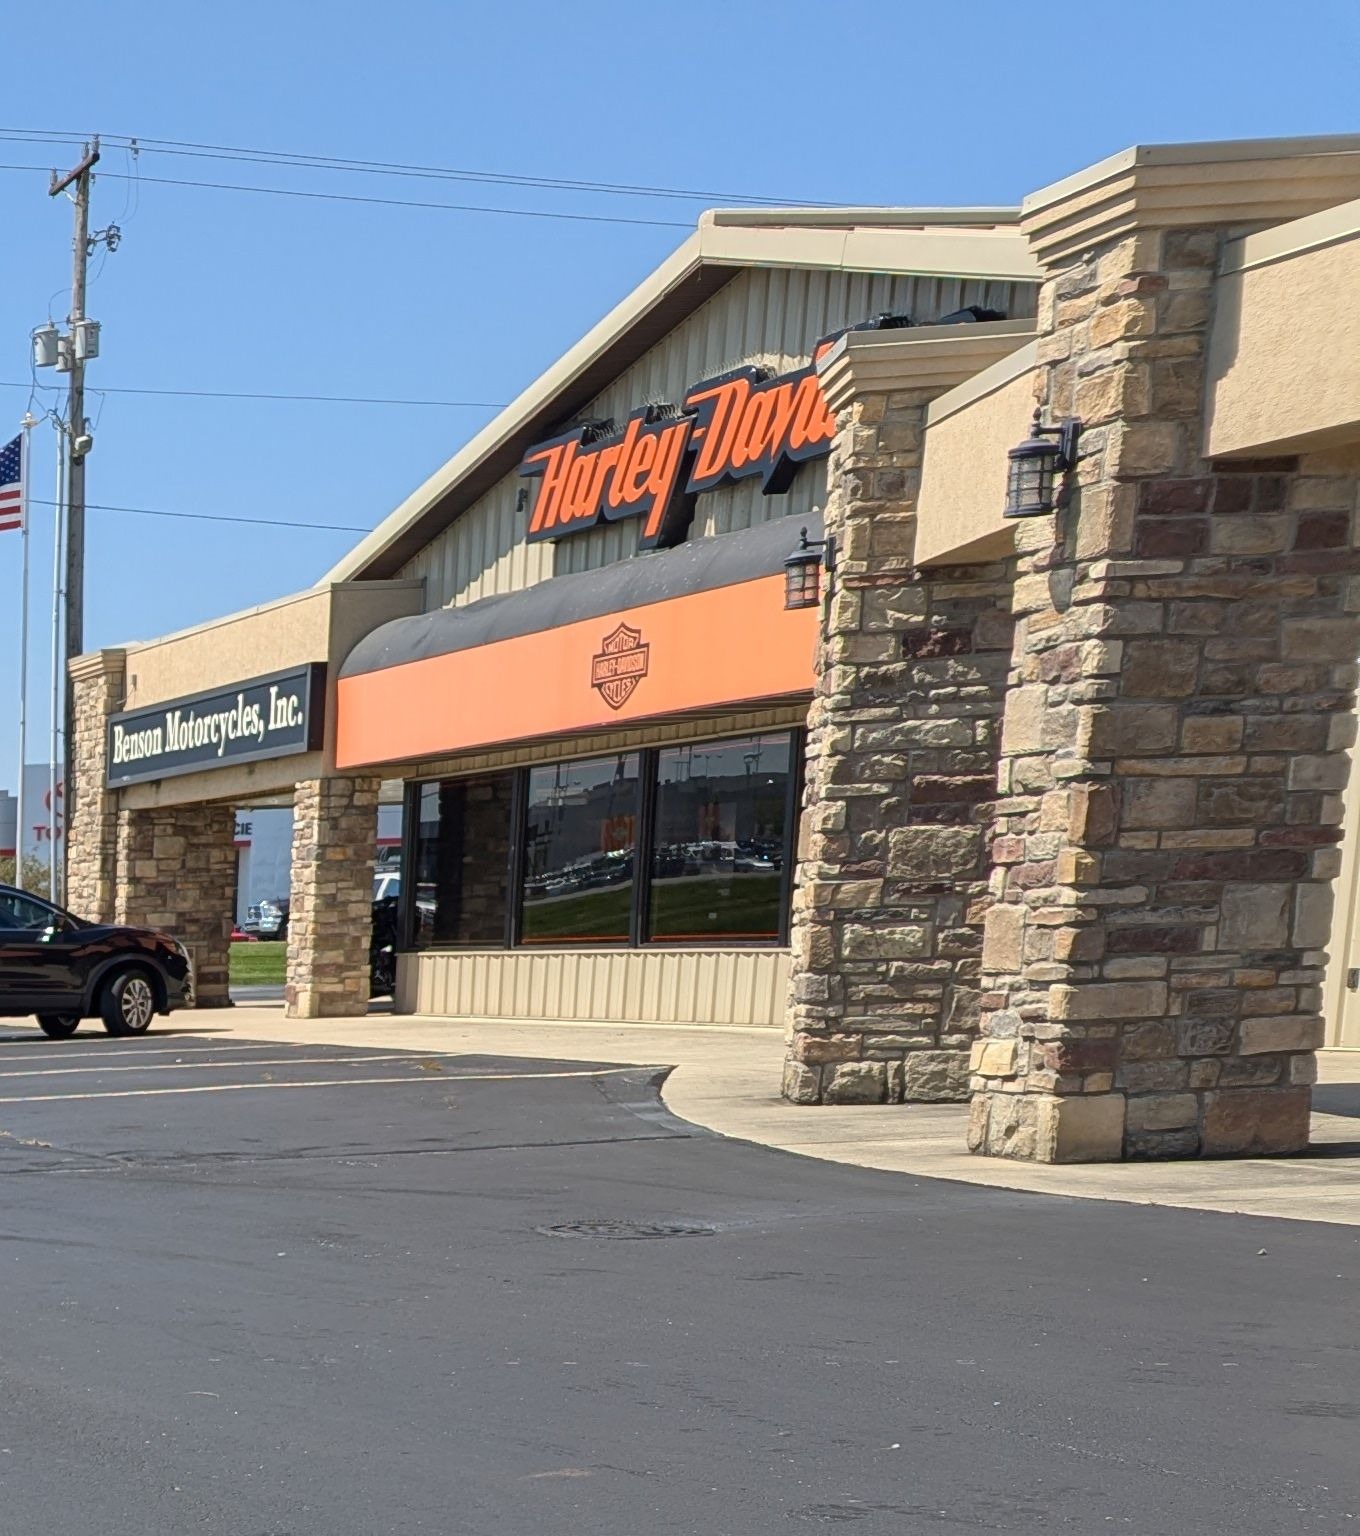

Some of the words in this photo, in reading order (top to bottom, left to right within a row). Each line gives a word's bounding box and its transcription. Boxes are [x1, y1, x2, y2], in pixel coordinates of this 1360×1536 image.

[112, 725, 162, 764] Benson
[165, 694, 264, 757] Motorcycles,
[267, 685, 303, 730] Inc.
